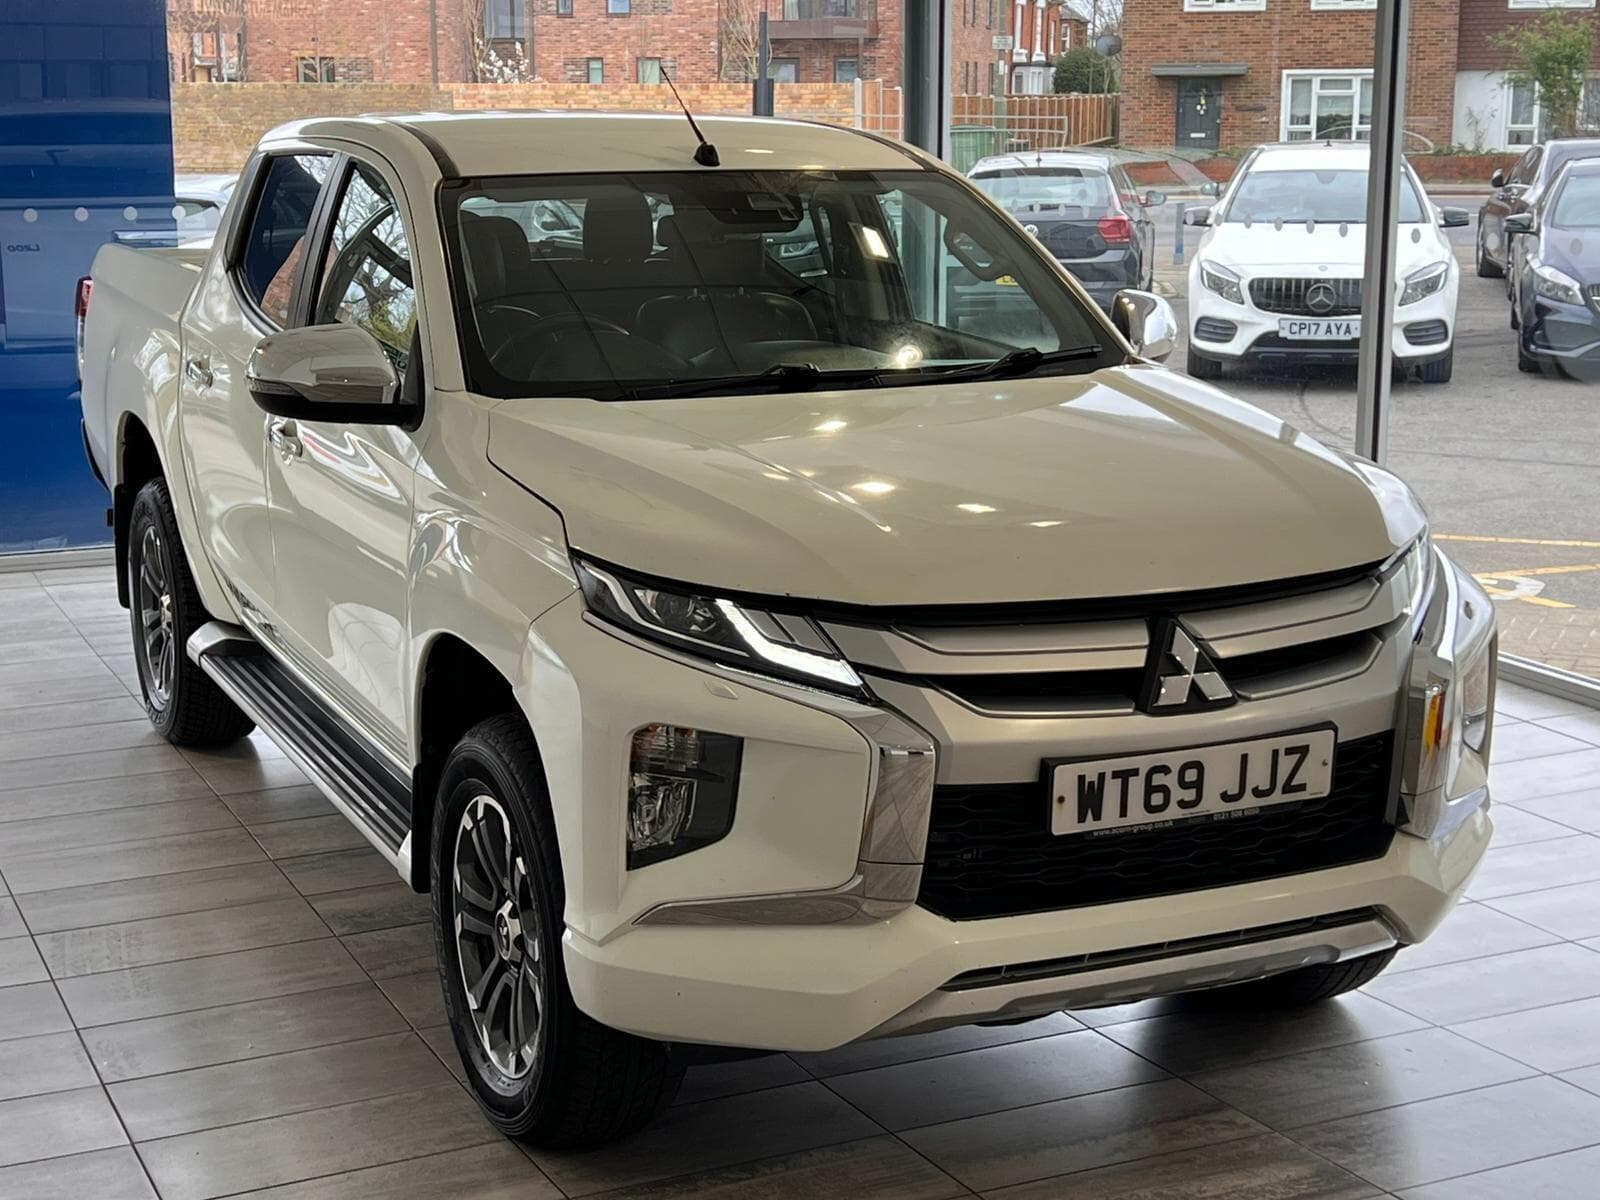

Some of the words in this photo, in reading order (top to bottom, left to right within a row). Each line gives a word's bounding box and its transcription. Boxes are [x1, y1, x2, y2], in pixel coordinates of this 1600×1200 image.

[1289, 322, 1320, 335] CP17
[1325, 323, 1352, 335] AYA
[1077, 760, 1205, 824] WT69
[1219, 744, 1310, 803] JJZ
